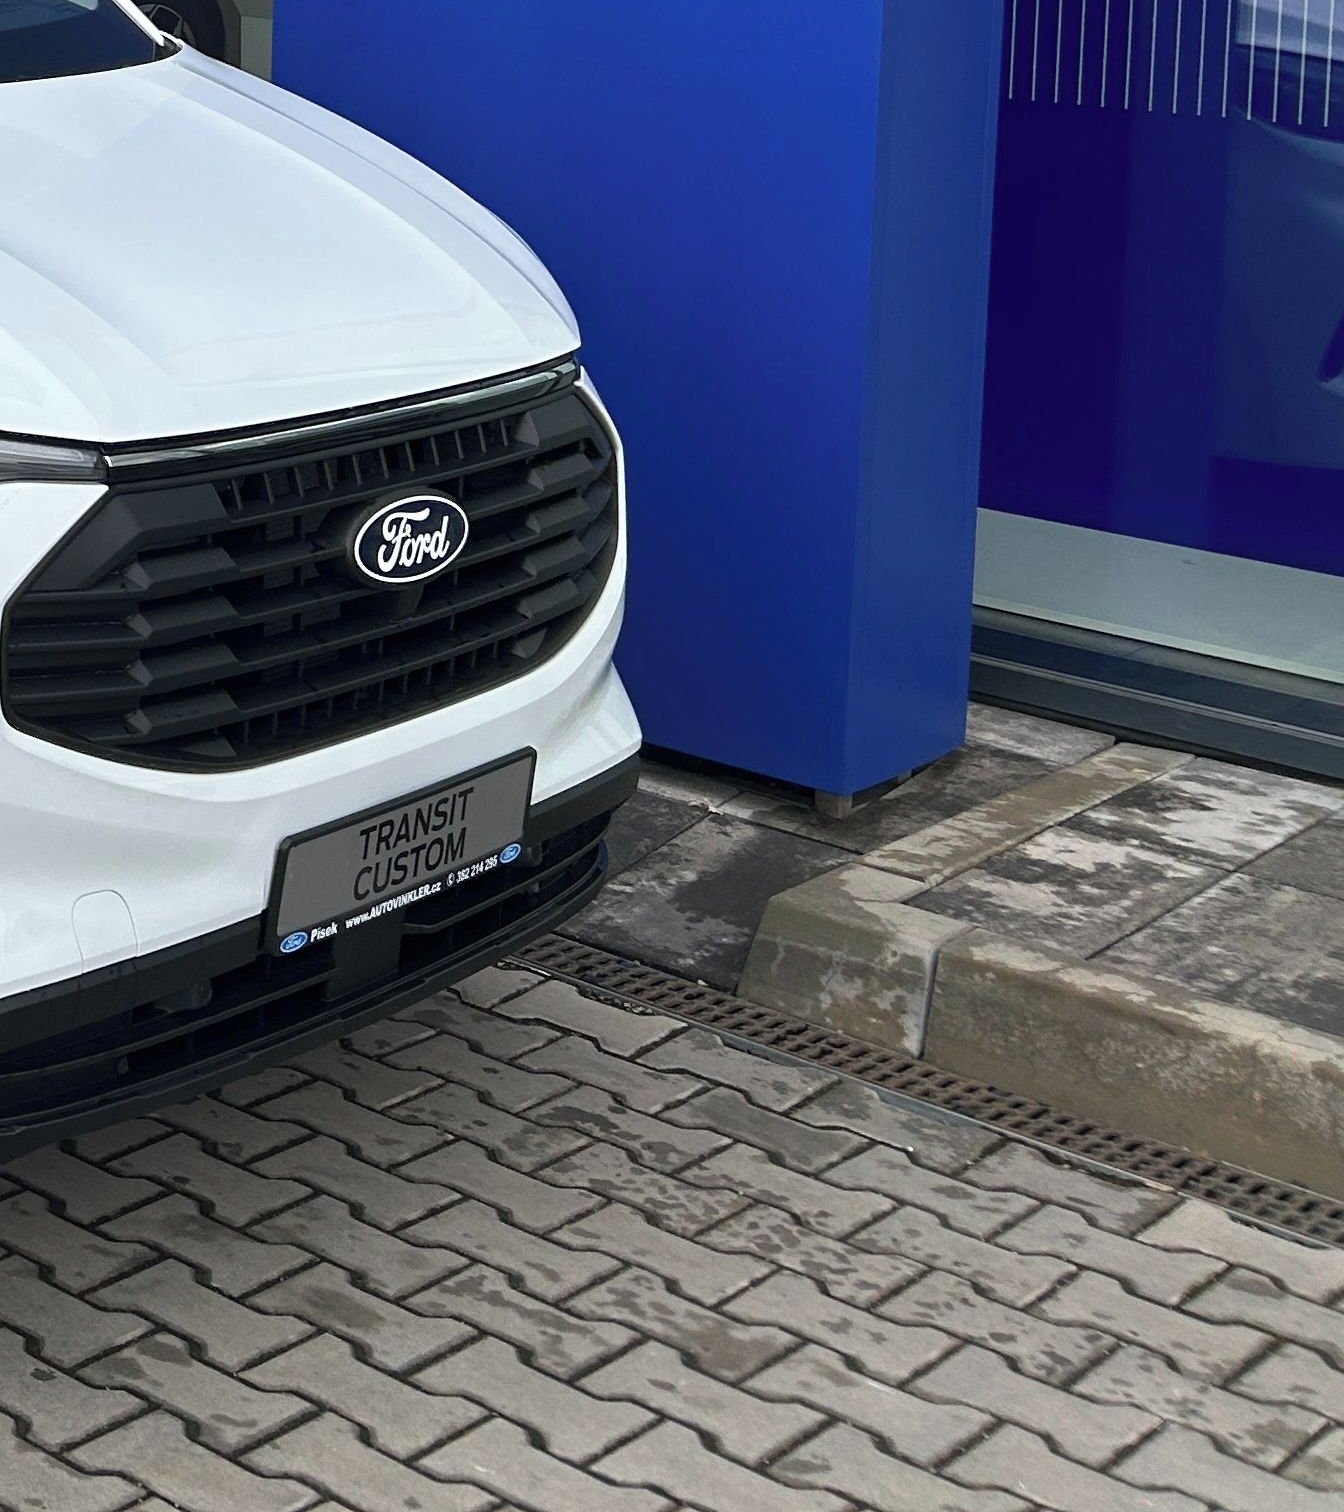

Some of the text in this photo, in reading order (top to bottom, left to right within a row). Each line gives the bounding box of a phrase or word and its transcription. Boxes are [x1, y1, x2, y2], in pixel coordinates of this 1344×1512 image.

[377, 507, 451, 574] Ford
[359, 786, 474, 862] TRANSIT
[345, 880, 442, 930] www.AUTOVINKLER.cz
[470, 861, 484, 878] 214
[352, 827, 467, 903] CUSTOM
